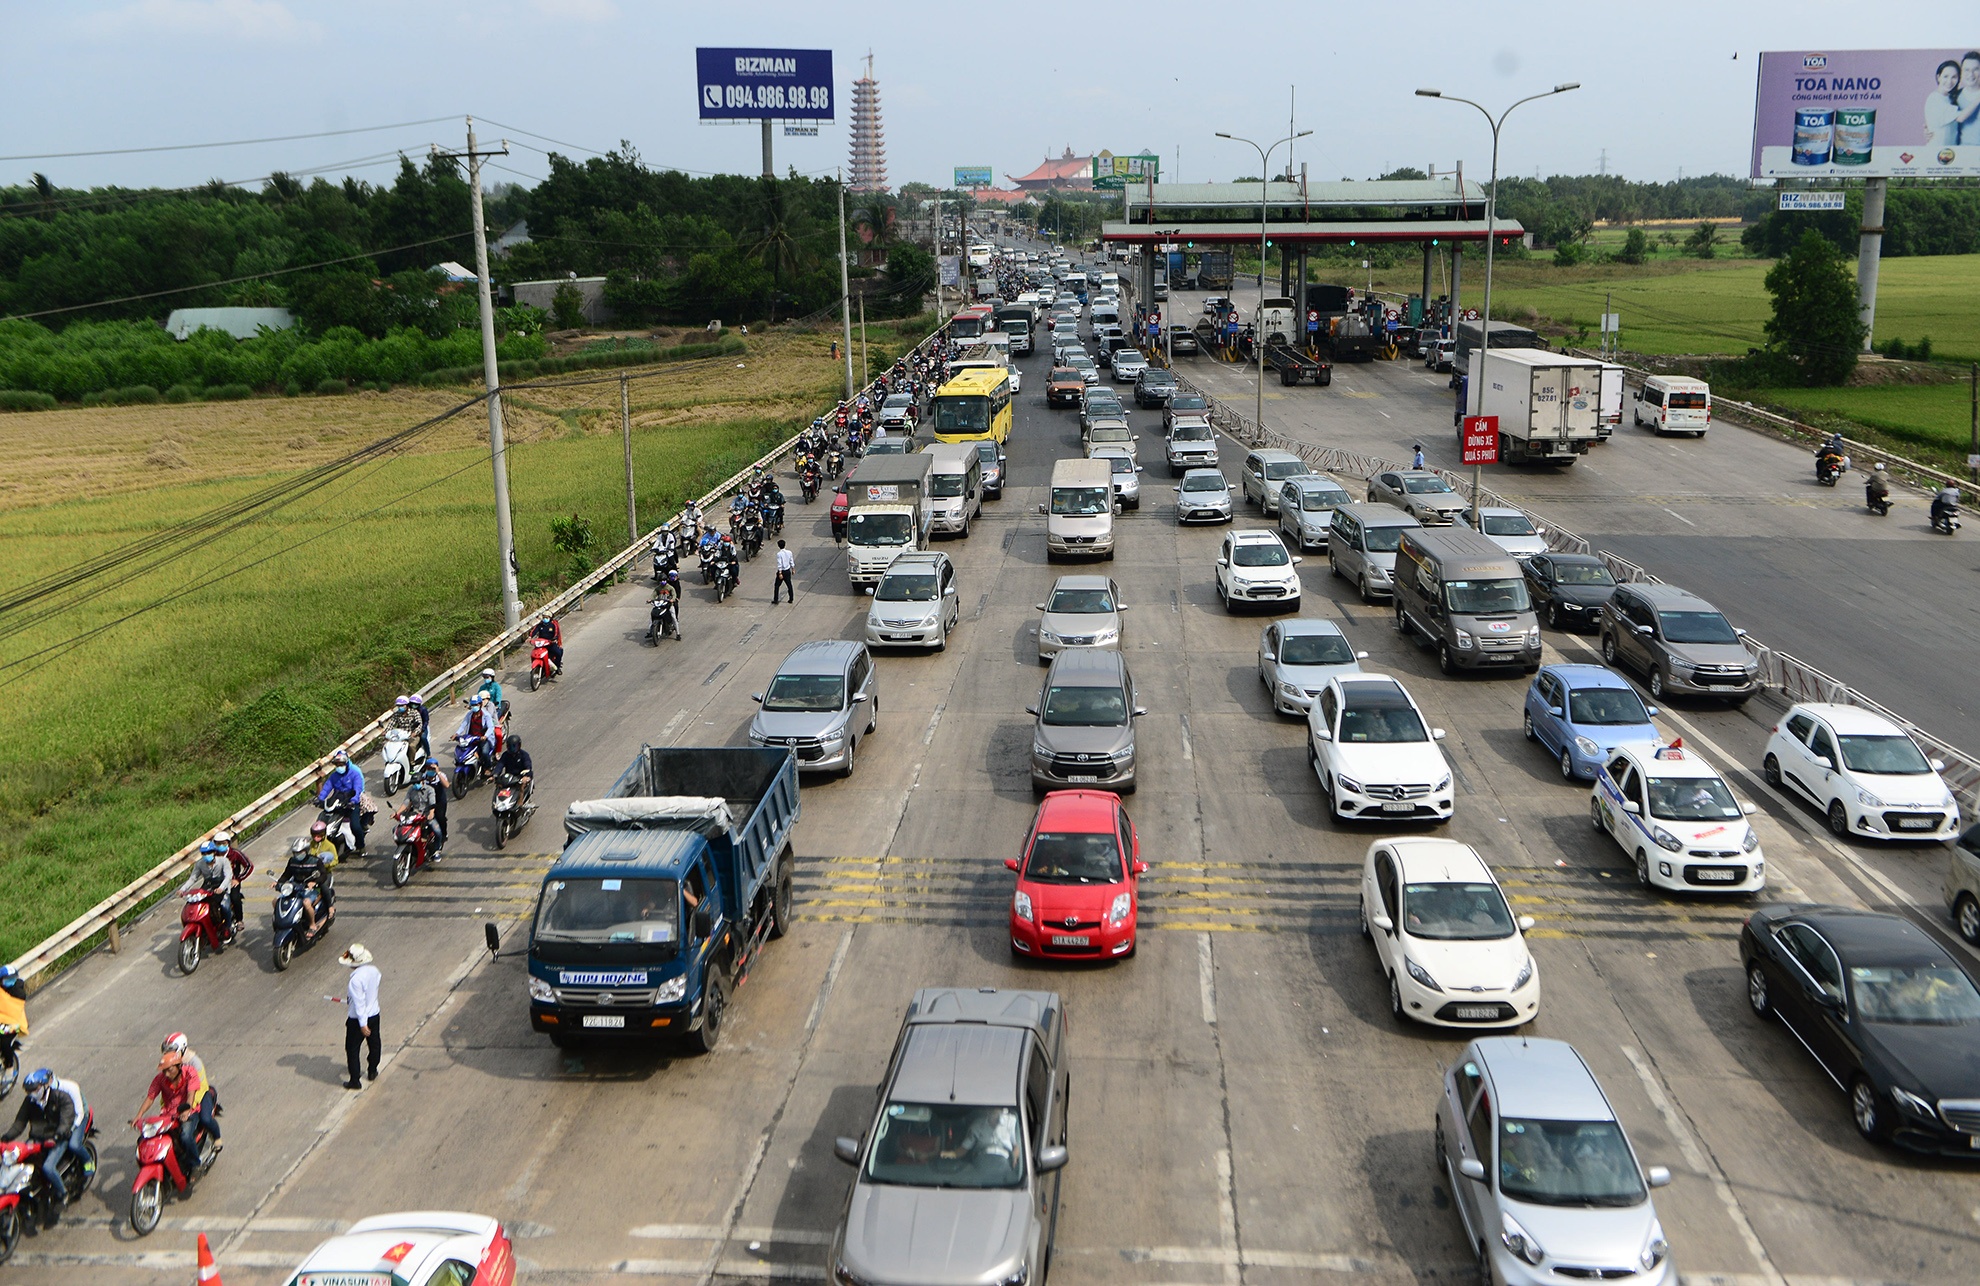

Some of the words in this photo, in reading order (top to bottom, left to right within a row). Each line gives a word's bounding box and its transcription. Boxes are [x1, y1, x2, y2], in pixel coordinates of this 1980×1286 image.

[735, 57, 796, 72] BIZMAN
[1805, 57, 1825, 67] TOA
[1795, 78, 1827, 91] TOA
[1832, 77, 1881, 91] NANO
[726, 85, 828, 109] 094.986.98.98
[1803, 116, 1826, 126] TOA
[1844, 115, 1867, 125] TOA
[1781, 193, 1843, 202] BIZMAN.VN
[1475, 417, 1488, 432] CẤM
[1485, 435, 1494, 446] XE
[1464, 448, 1476, 461] QUÁ
[1476, 450, 1481, 461] 5
[1481, 447, 1496, 460] PHÚT
